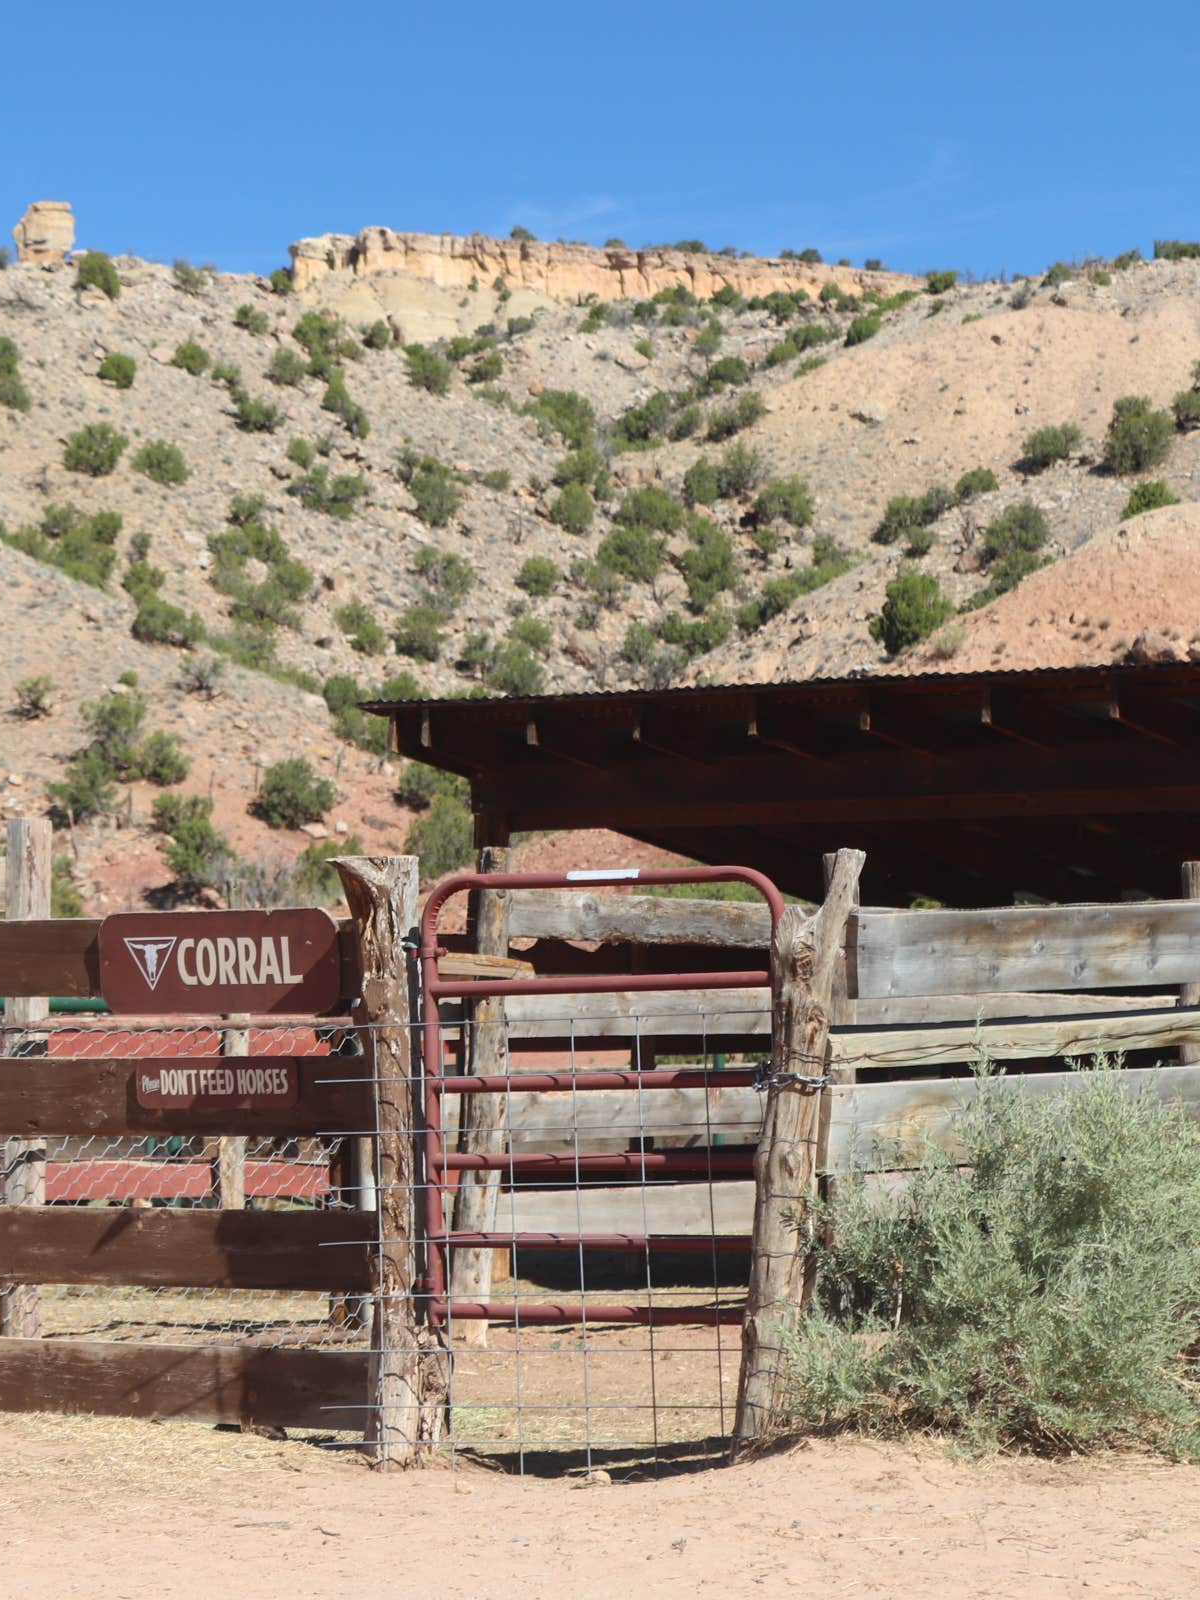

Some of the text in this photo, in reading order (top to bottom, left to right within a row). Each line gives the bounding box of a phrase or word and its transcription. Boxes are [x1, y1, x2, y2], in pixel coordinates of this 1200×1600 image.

[177, 936, 303, 986] CORRAL
[200, 1069, 234, 1096] FEED
[237, 1068, 288, 1096] HORSES
